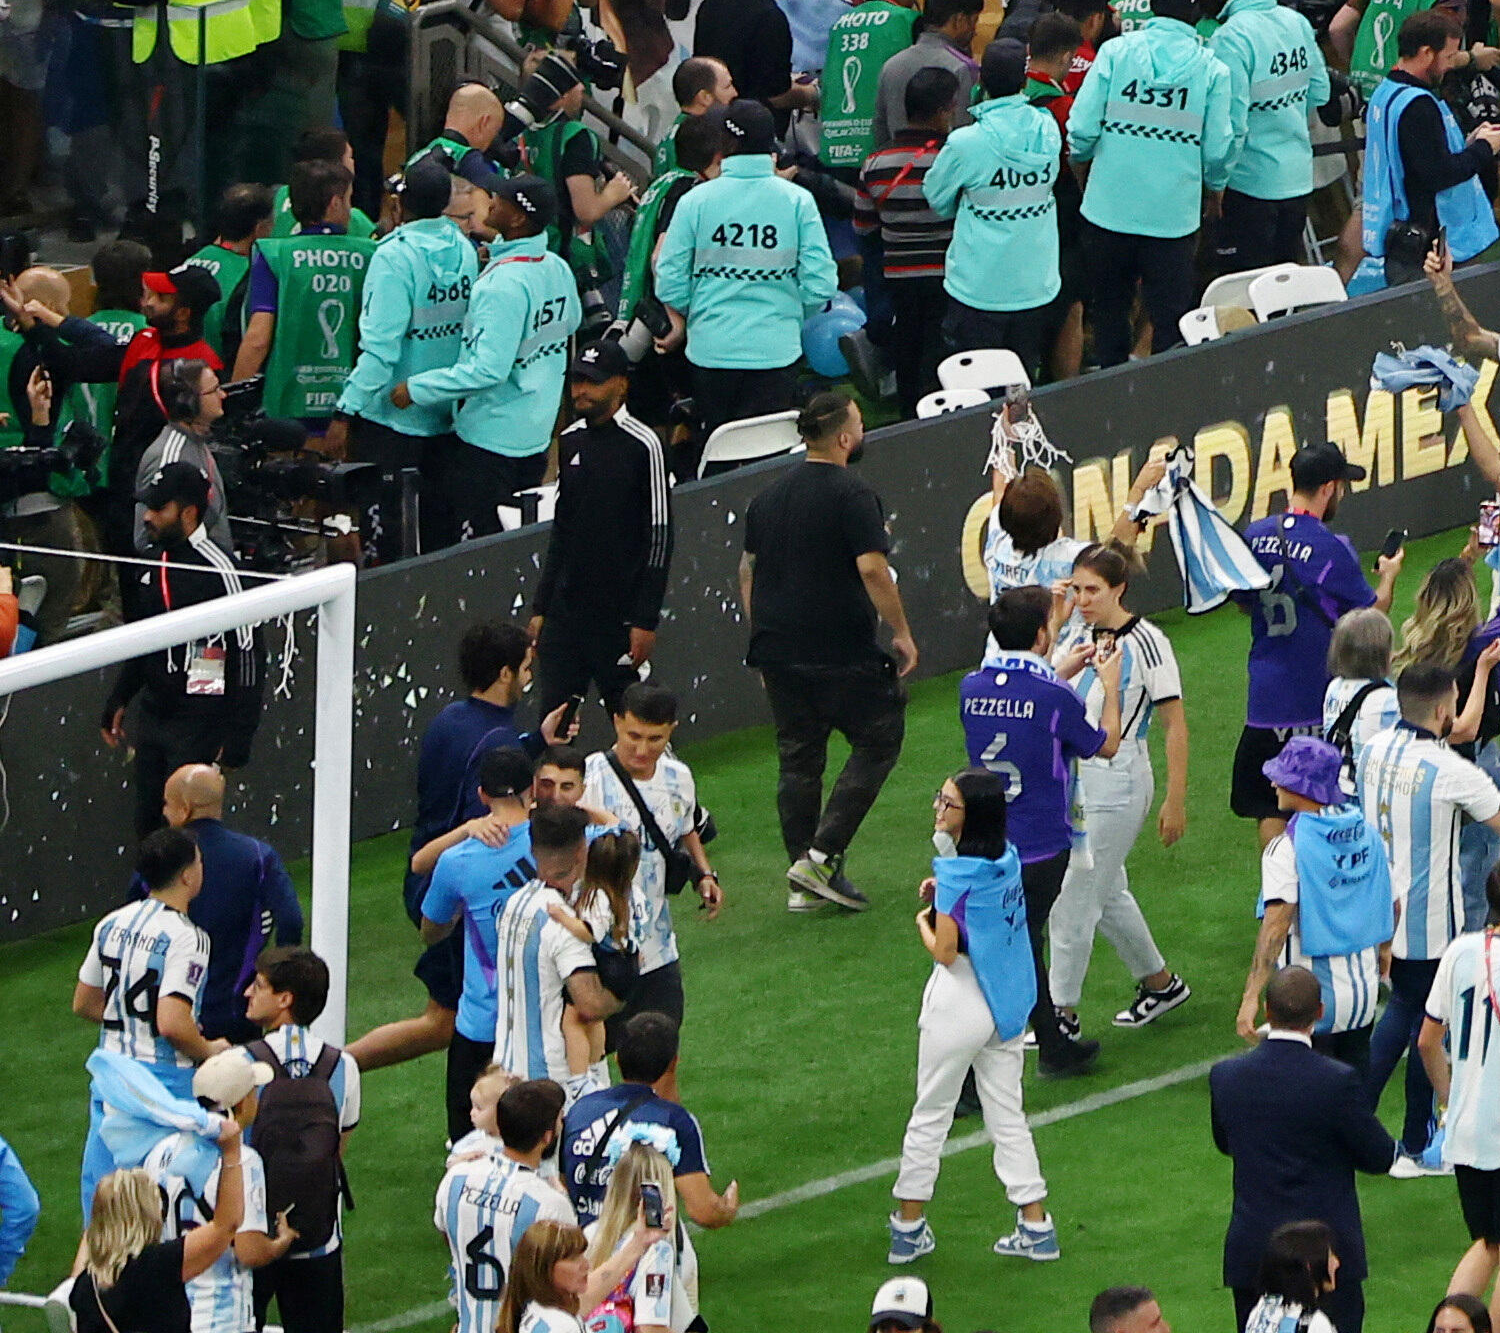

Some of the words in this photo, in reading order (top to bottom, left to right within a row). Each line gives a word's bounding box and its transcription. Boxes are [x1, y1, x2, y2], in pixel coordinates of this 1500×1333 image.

[841, 33, 868, 51] 338
[712, 224, 778, 248] 4218
[294, 250, 364, 269] PHOTO
[313, 274, 350, 291] 020
[964, 698, 1034, 718] PEZZELLA
[981, 732, 1022, 800] 6
[1331, 848, 1370, 867] YPF
[110, 924, 169, 956] FERNANDEZ
[101, 957, 159, 1036] 24
[1458, 985, 1496, 1064] 11
[459, 1182, 520, 1215] PEZZELLA
[466, 1224, 506, 1302] 6
